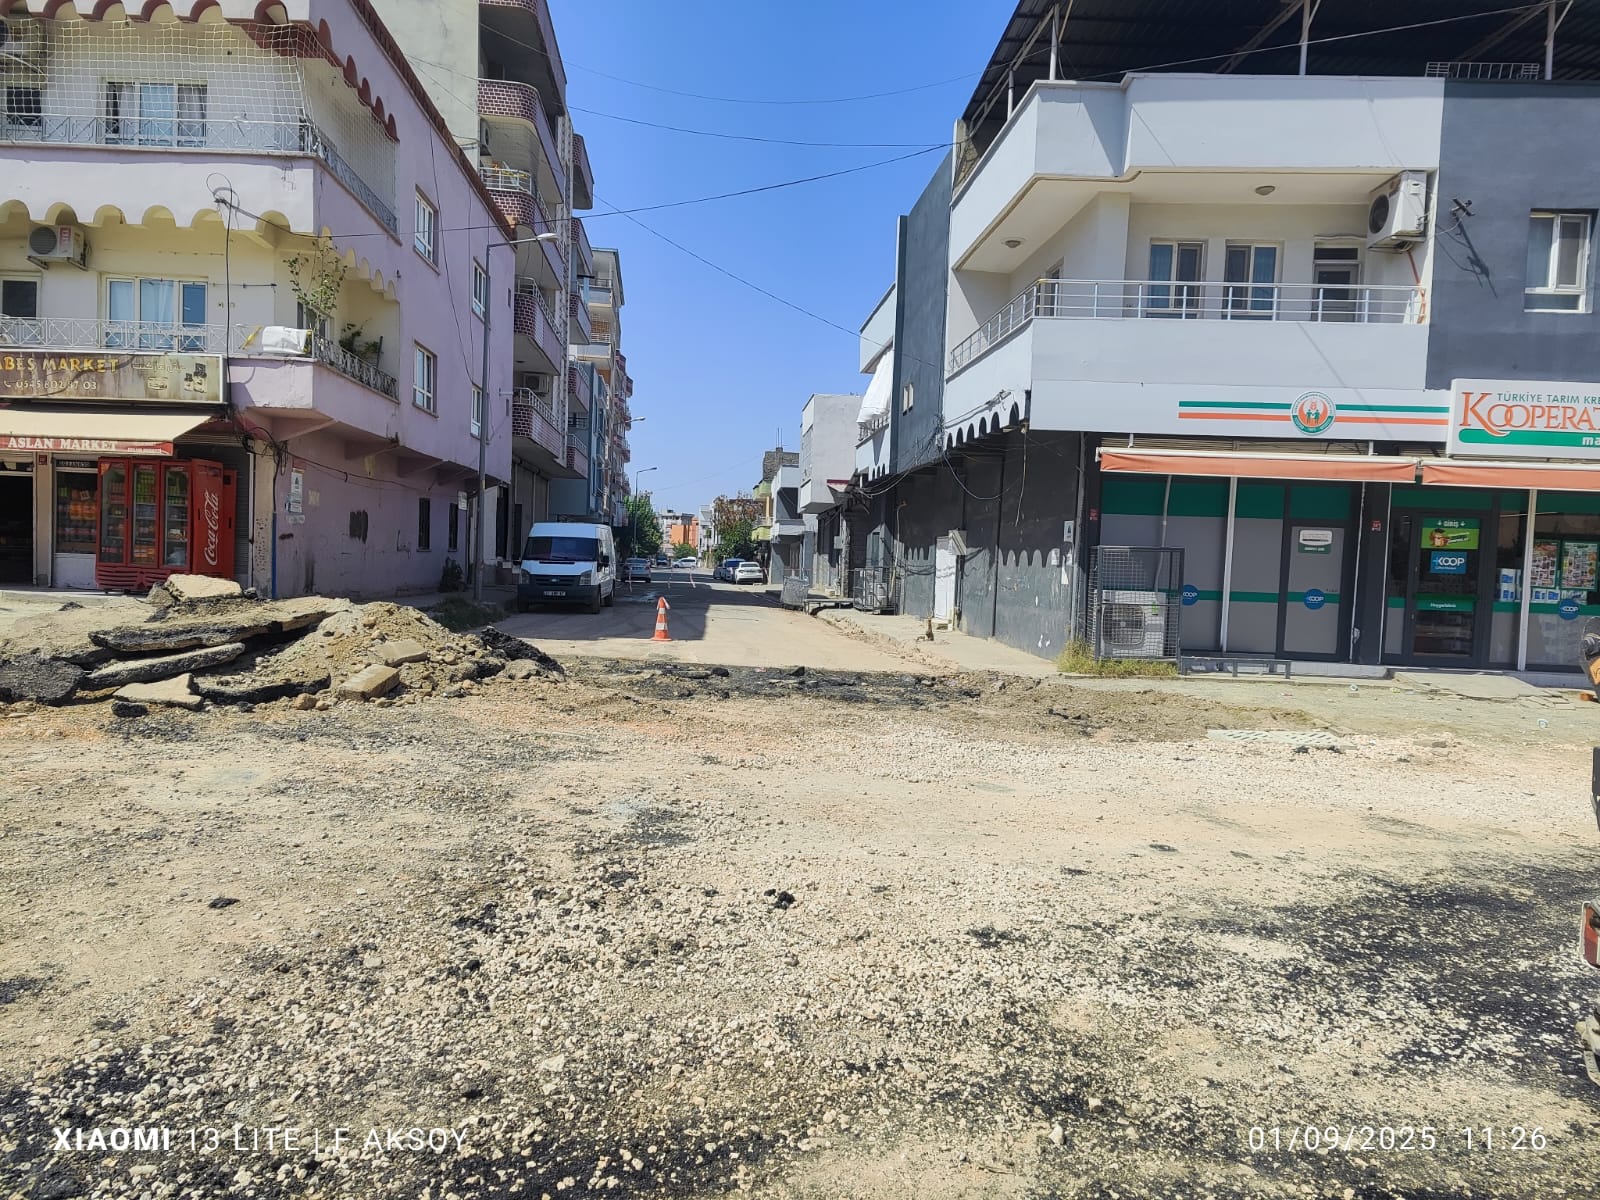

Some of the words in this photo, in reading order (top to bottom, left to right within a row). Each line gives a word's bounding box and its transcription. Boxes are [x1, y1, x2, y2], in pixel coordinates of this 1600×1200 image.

[0, 355, 37, 370] BES
[42, 358, 119, 373] MARKET
[83, 381, 97, 390] 03
[1497, 391, 1542, 403] TÜRKİYE
[1546, 394, 1580, 404] TARIM
[7, 437, 55, 449] ASLAN
[60, 438, 119, 451] MARKET
[1436, 556, 1465, 566] KOOP
